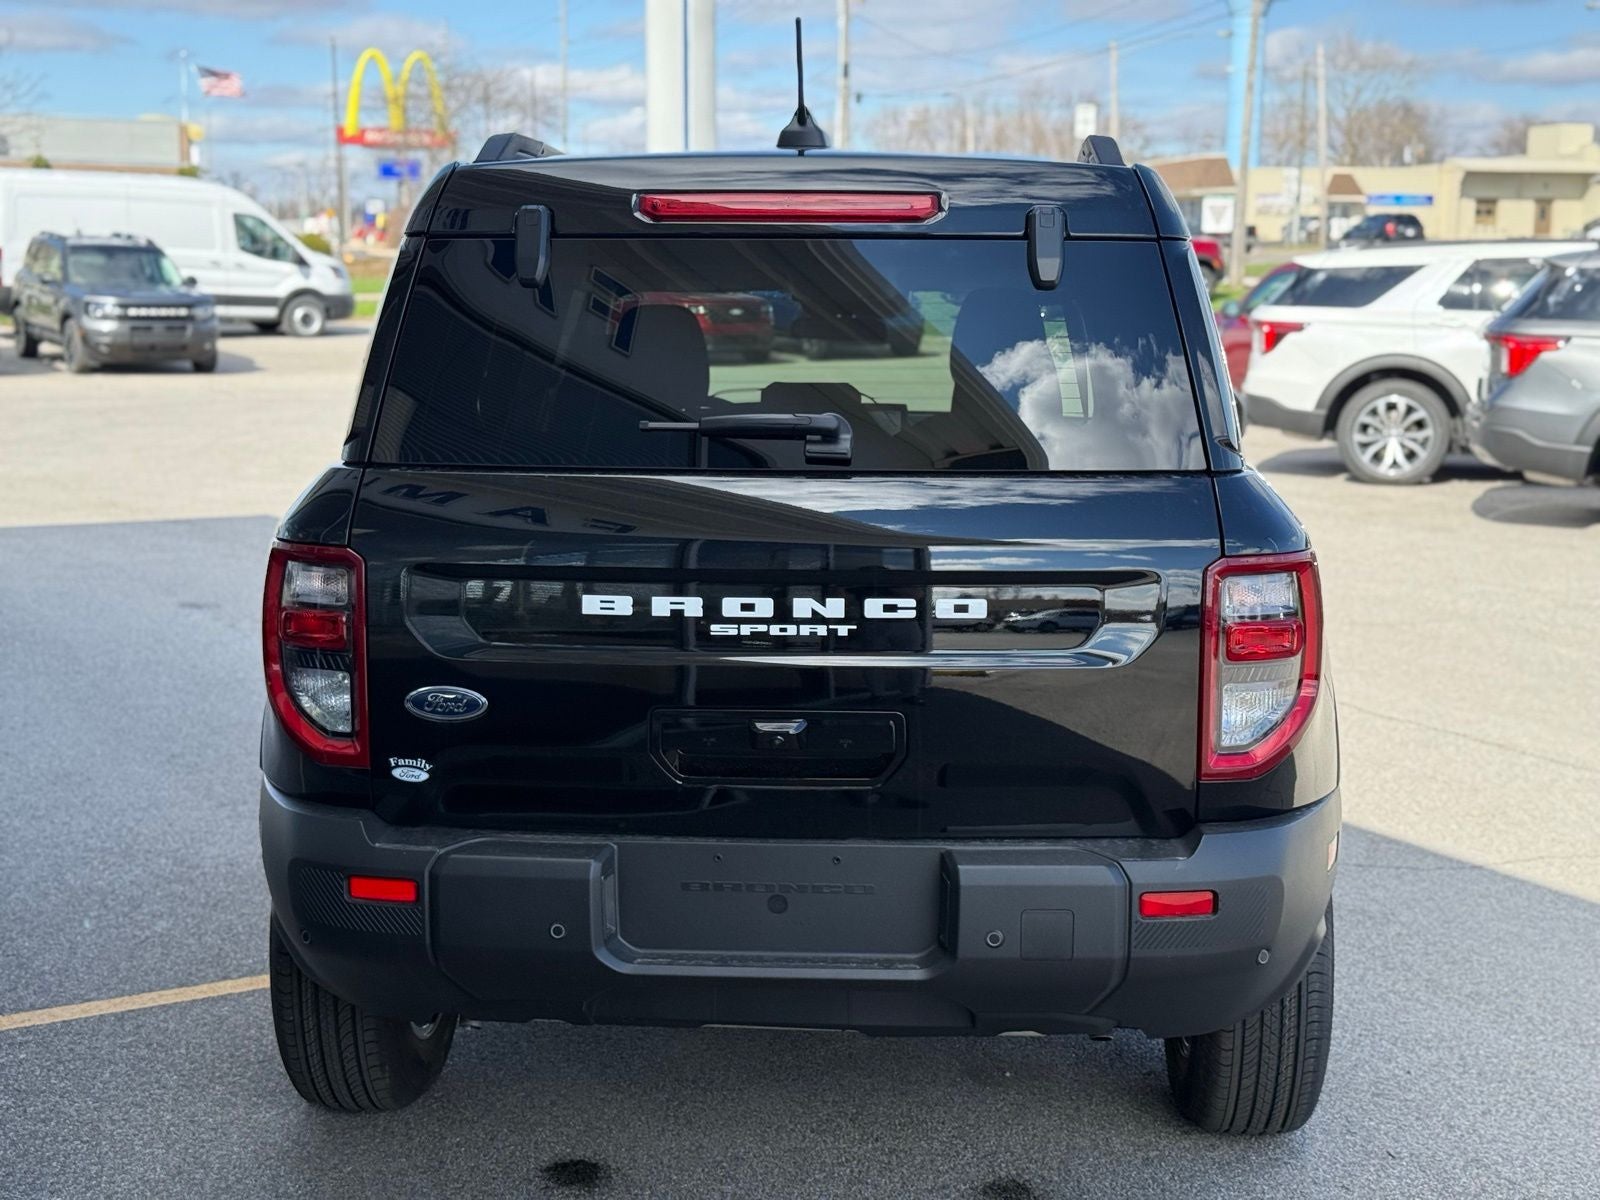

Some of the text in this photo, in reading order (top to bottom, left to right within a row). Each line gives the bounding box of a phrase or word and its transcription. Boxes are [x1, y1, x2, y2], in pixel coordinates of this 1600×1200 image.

[581, 594, 988, 619] BRONCO
[709, 623, 858, 637] SPORT
[424, 692, 467, 712] Ford
[389, 757, 433, 771] Family
[399, 769, 422, 780] Ford
[681, 881, 876, 895] BRONCO
